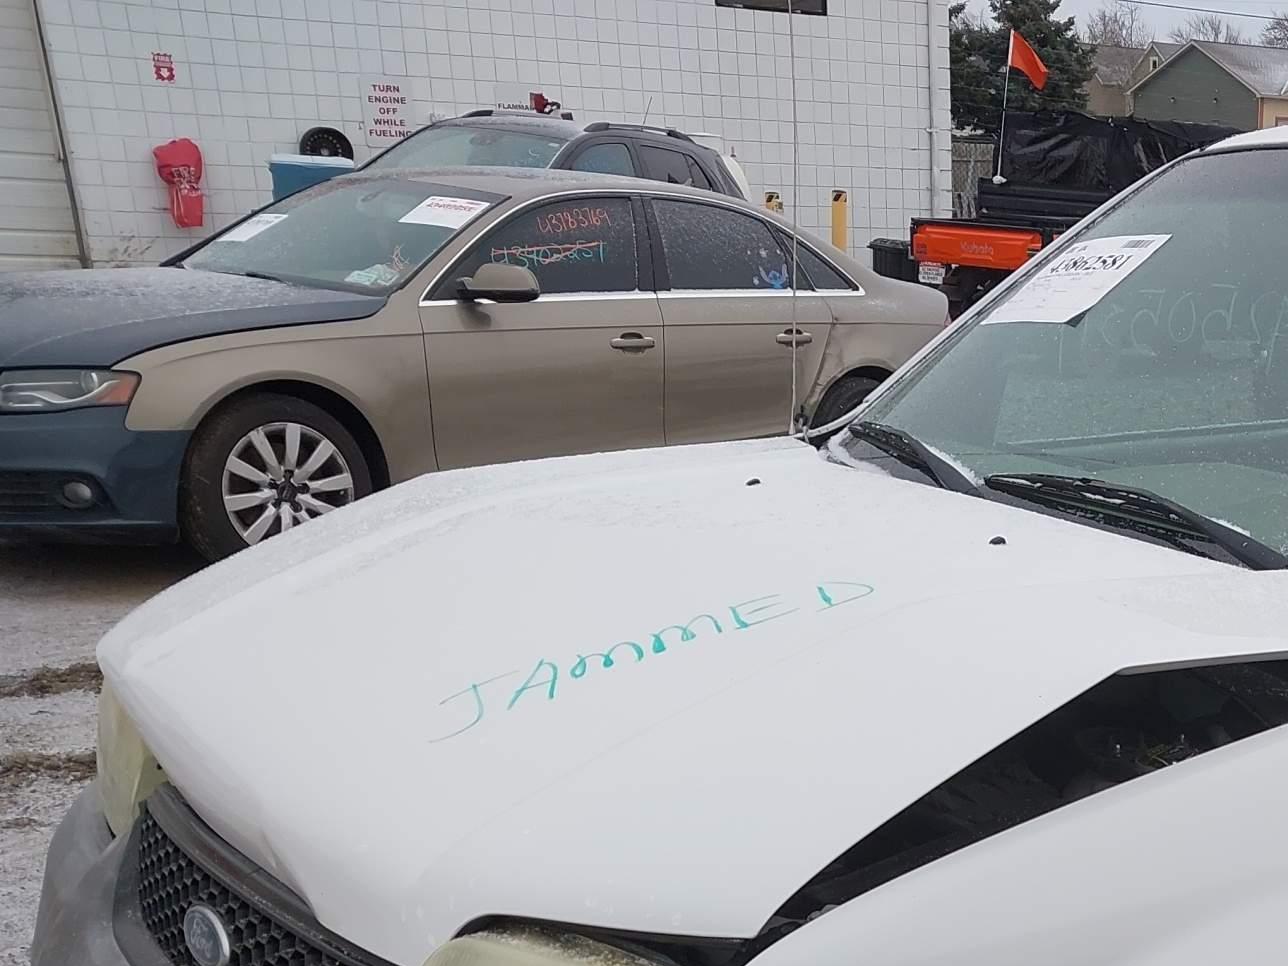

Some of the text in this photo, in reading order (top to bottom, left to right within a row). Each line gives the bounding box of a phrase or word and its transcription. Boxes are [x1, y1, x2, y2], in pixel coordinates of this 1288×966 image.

[372, 84, 400, 93] TURN
[368, 95, 407, 105] ENGINE
[378, 107, 398, 115] OFF
[497, 103, 530, 111] FLAMMA
[373, 118, 406, 127] WHILE
[428, 581, 875, 744] JAMMED
